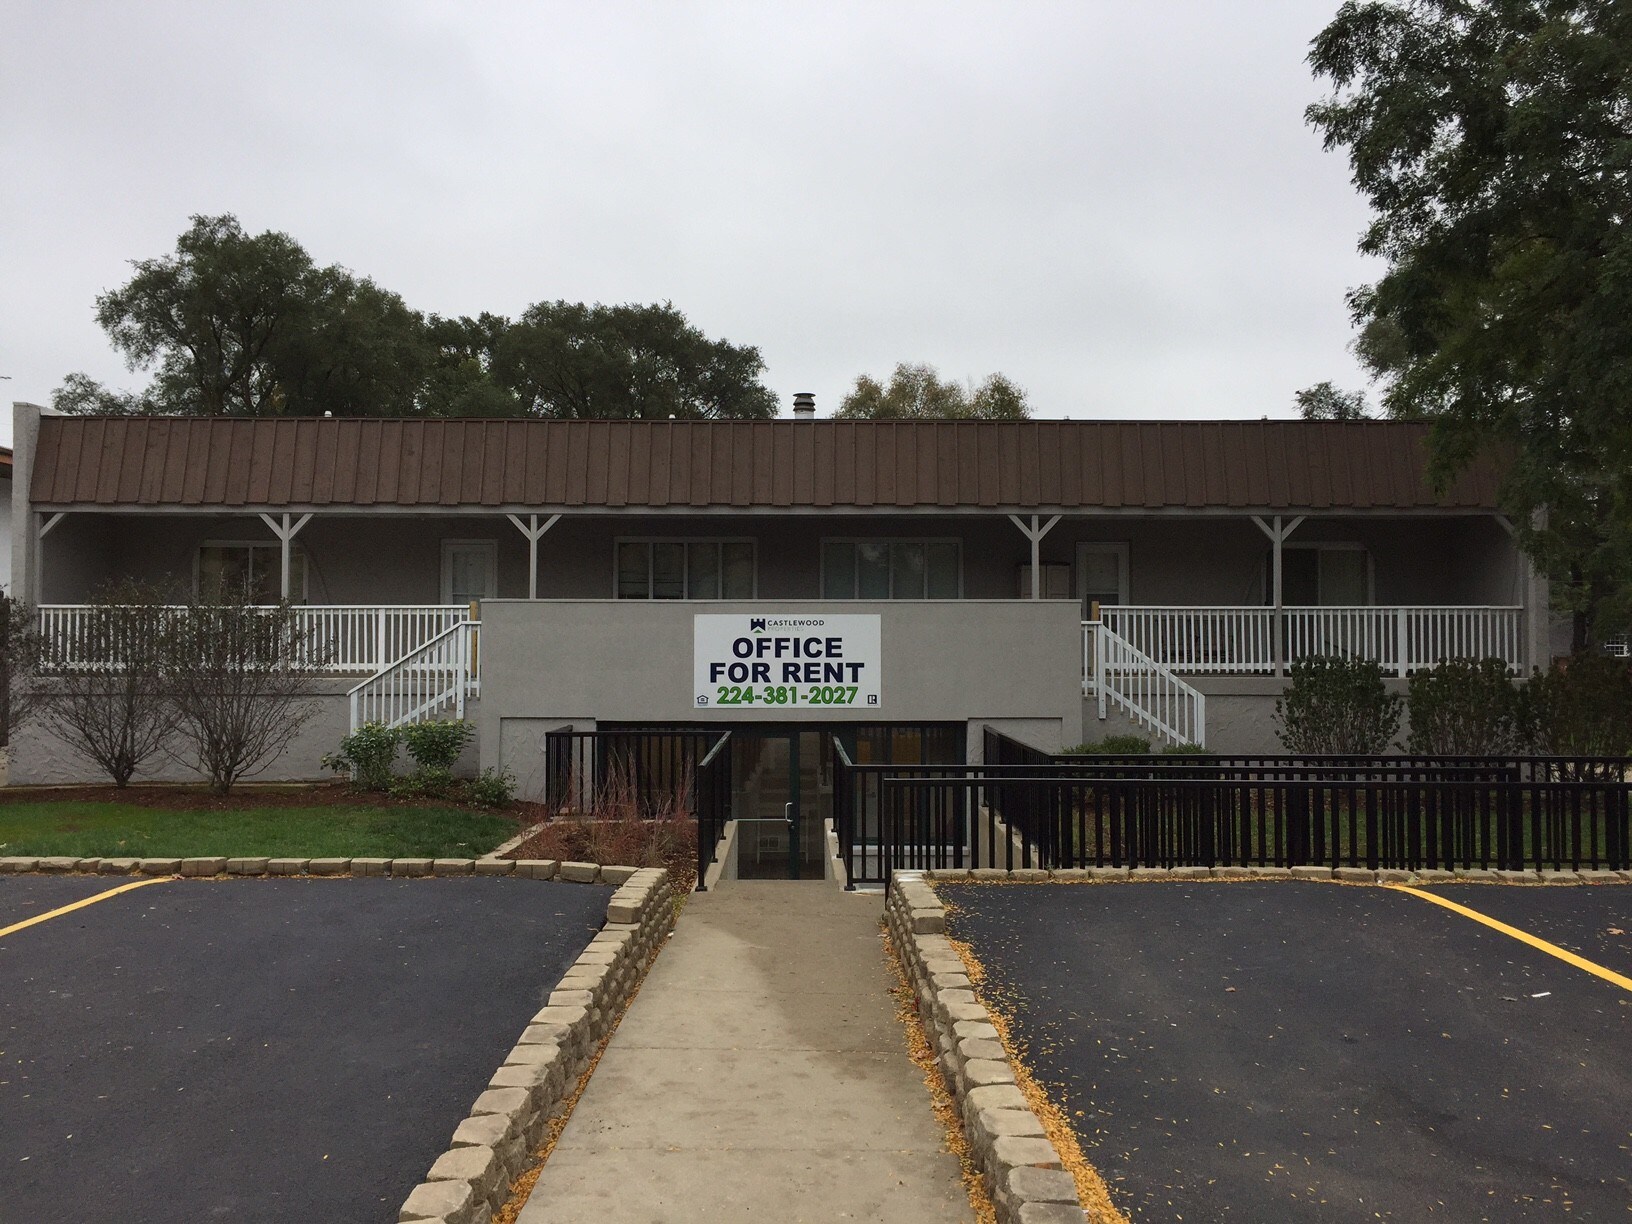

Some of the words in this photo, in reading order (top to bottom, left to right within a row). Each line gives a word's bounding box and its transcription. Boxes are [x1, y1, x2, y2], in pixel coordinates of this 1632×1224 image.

[732, 637, 843, 659] OFFICE
[710, 662, 771, 684] FOR
[782, 662, 865, 684] RENT
[716, 686, 859, 705] 224-381-2027
